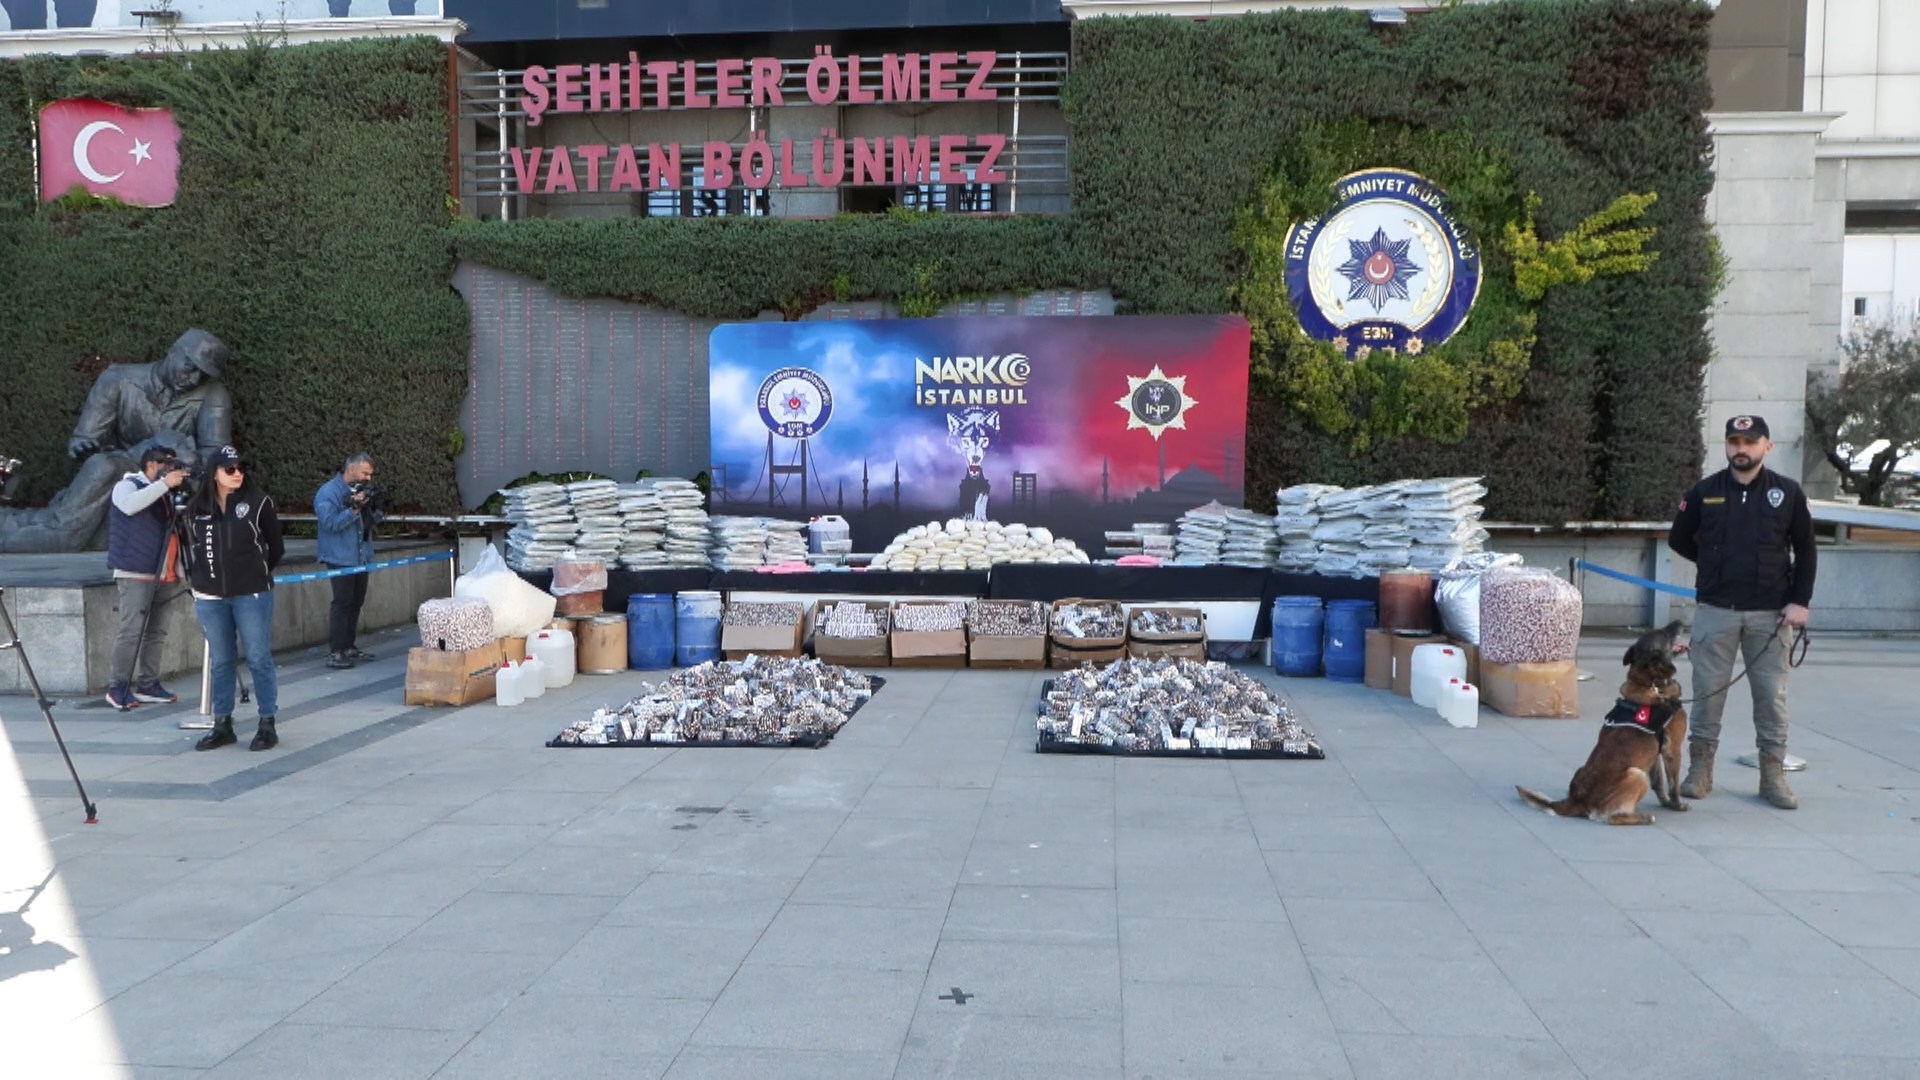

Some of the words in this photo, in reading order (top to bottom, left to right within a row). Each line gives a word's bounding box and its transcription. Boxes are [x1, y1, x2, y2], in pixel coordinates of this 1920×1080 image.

[521, 51, 784, 126] ŞEHİTLER
[805, 45, 998, 105] ÖLMEZ
[510, 142, 681, 194] VATAN
[703, 128, 1007, 189] BÖLÜNMEZ
[916, 384, 1028, 405] İSTANBUL
